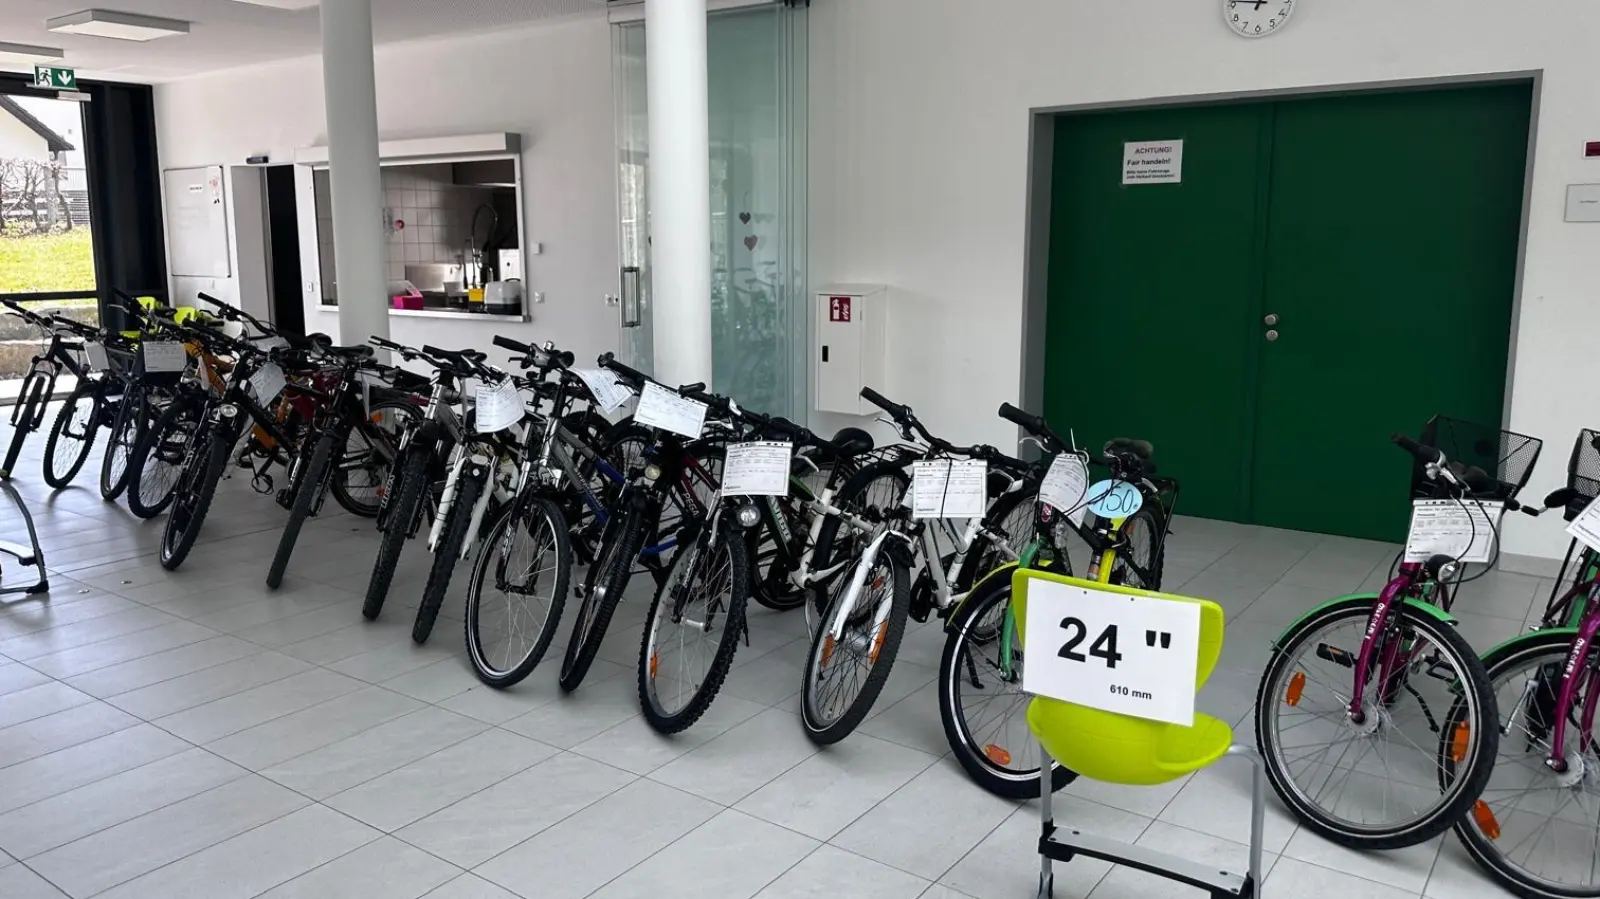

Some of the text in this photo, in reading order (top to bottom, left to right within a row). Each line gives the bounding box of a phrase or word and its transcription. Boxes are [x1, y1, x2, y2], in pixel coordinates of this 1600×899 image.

[1233, 14, 1239, 22] 8
[1269, 18, 1275, 27] 5
[1242, 21, 1248, 30] 7
[1254, 25, 1261, 33] 6
[1134, 146, 1172, 154] ACHTUNG!
[1127, 157, 1171, 166] Fair handeln!
[1057, 616, 1123, 669] 24
[1110, 684, 1152, 700] 610 mm
